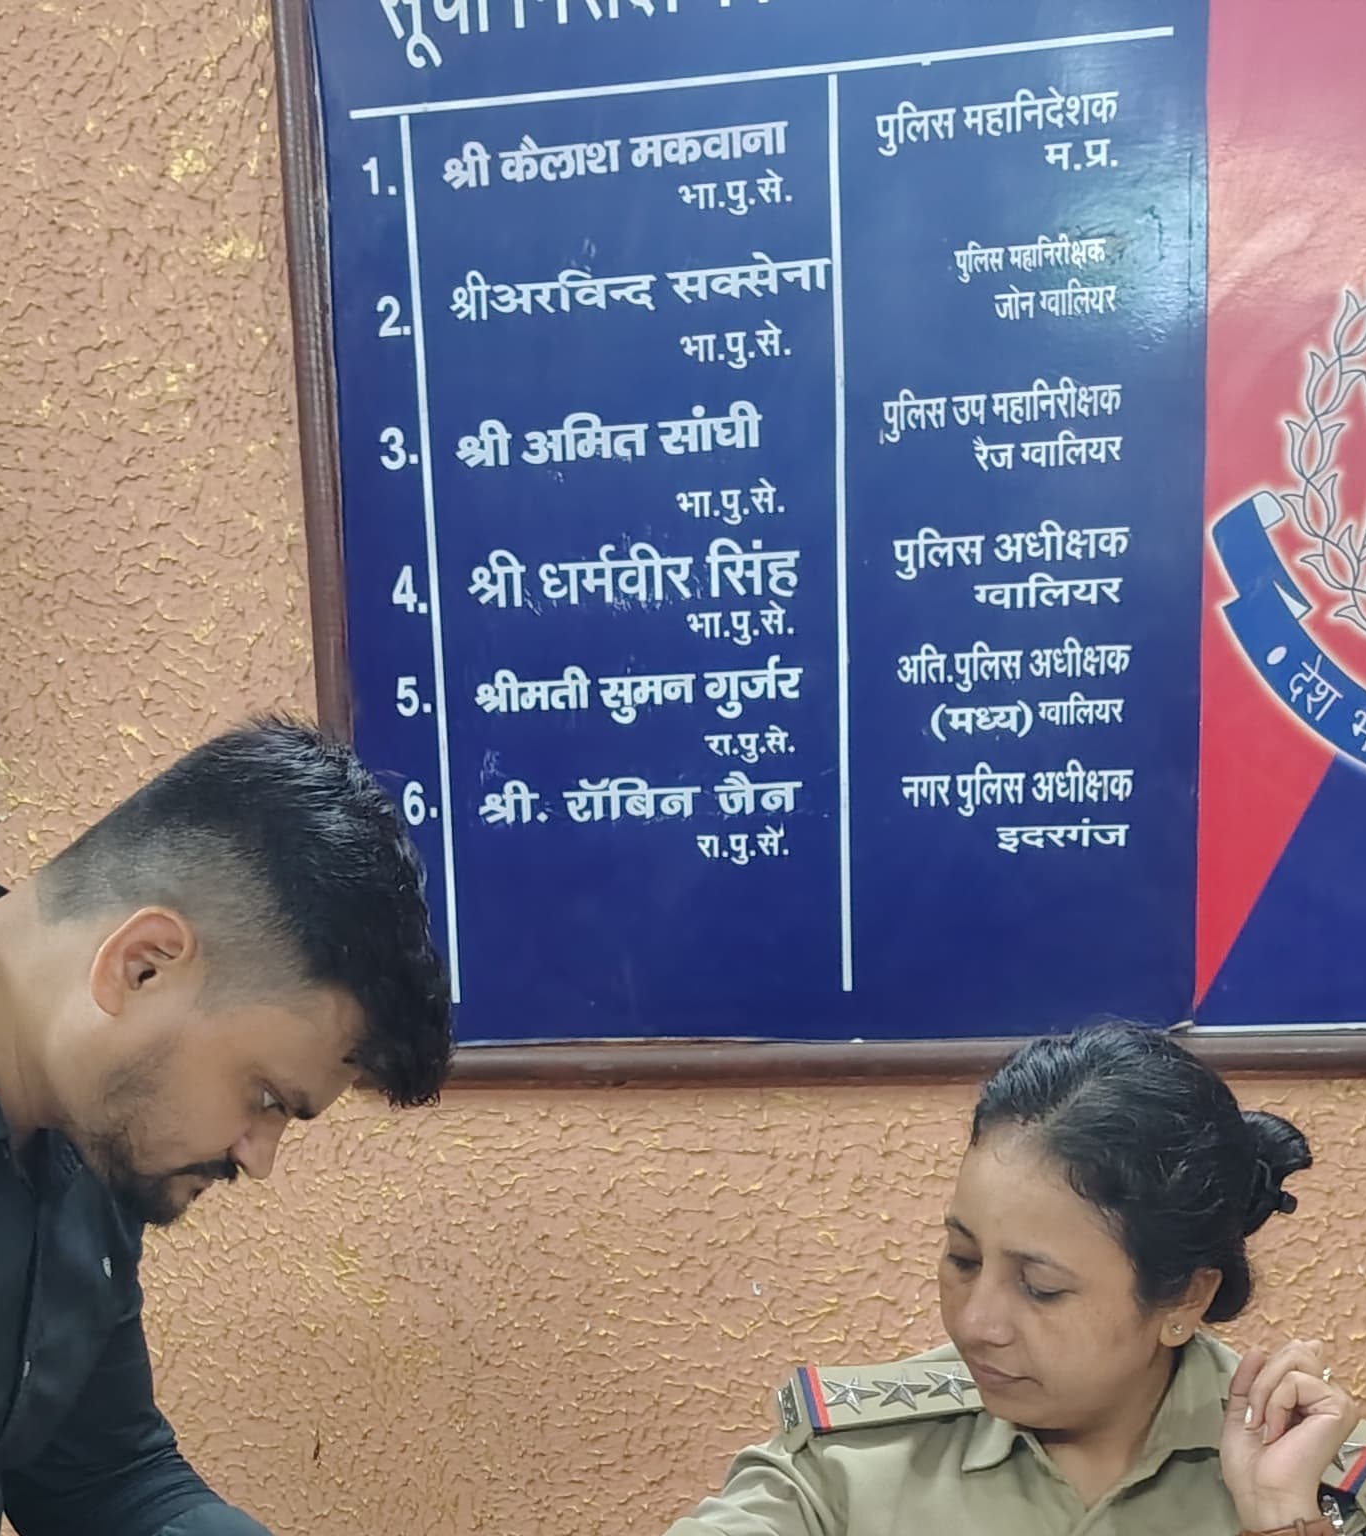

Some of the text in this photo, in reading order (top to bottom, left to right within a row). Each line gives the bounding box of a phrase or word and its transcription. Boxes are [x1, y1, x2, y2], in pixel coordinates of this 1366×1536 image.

[875, 86, 1120, 157] पुलिस महानिदेशक
[362, 156, 397, 196] 1.
[442, 120, 789, 190] श्री कैलाश मकवाना
[376, 295, 412, 338] 2.
[455, 419, 512, 468] श्री
[521, 411, 649, 465] अमित
[879, 388, 948, 445] पुलिस
[951, 393, 988, 426] उप
[379, 426, 419, 471] 3.
[467, 537, 800, 609] श्री धर्मवीर सिंह
[892, 519, 1130, 581] पुलिस अधीक्षक
[392, 565, 428, 614] 4.
[1029, 636, 1132, 679] अधीक्षक
[396, 676, 432, 717] 5.
[474, 665, 591, 713] श्रीमती
[598, 673, 697, 725] सुमन
[1288, 652, 1344, 722] देश
[402, 781, 438, 826] 6.
[713, 770, 803, 815] जैन
[901, 758, 1134, 817] नगर पुलिस अधीक्षक
